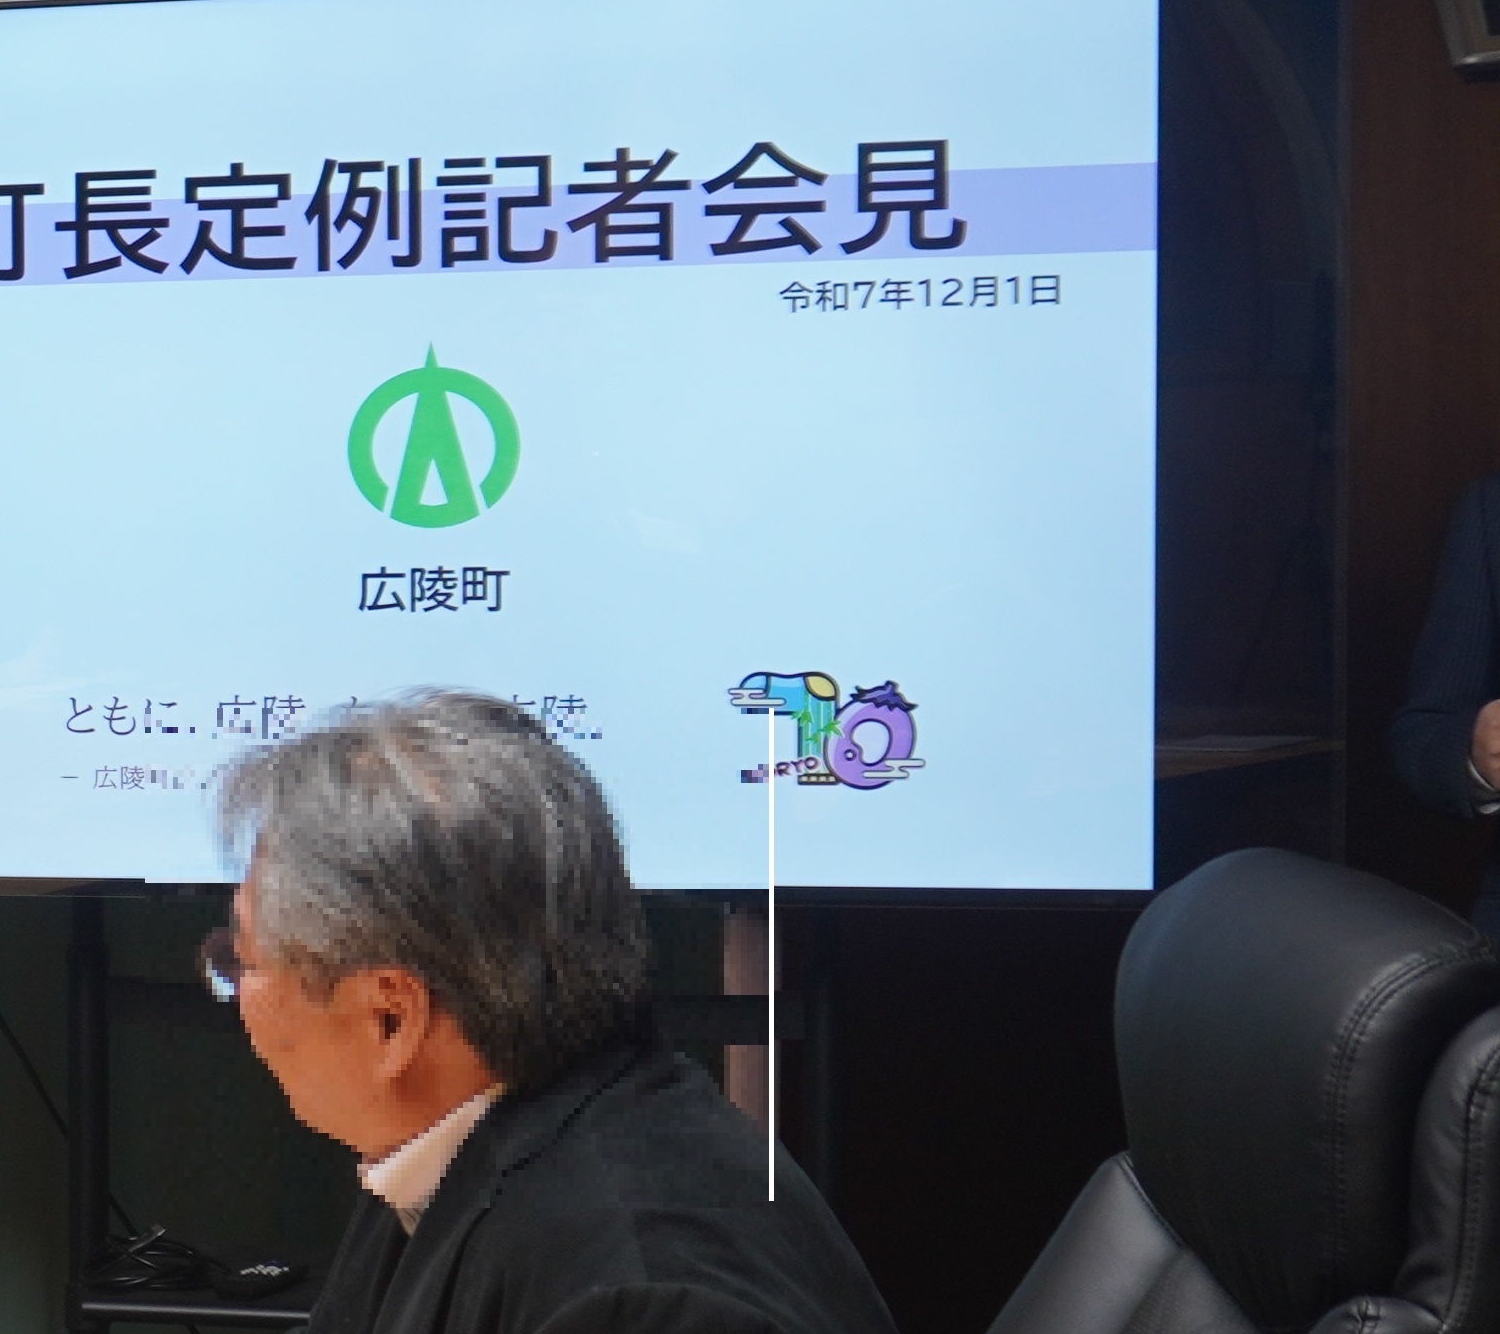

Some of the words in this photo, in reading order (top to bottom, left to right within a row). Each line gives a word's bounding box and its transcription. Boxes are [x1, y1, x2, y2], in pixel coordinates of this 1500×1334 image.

[779, 274, 1061, 313] 令和7年12月1日
[358, 565, 511, 613] 広陵町
